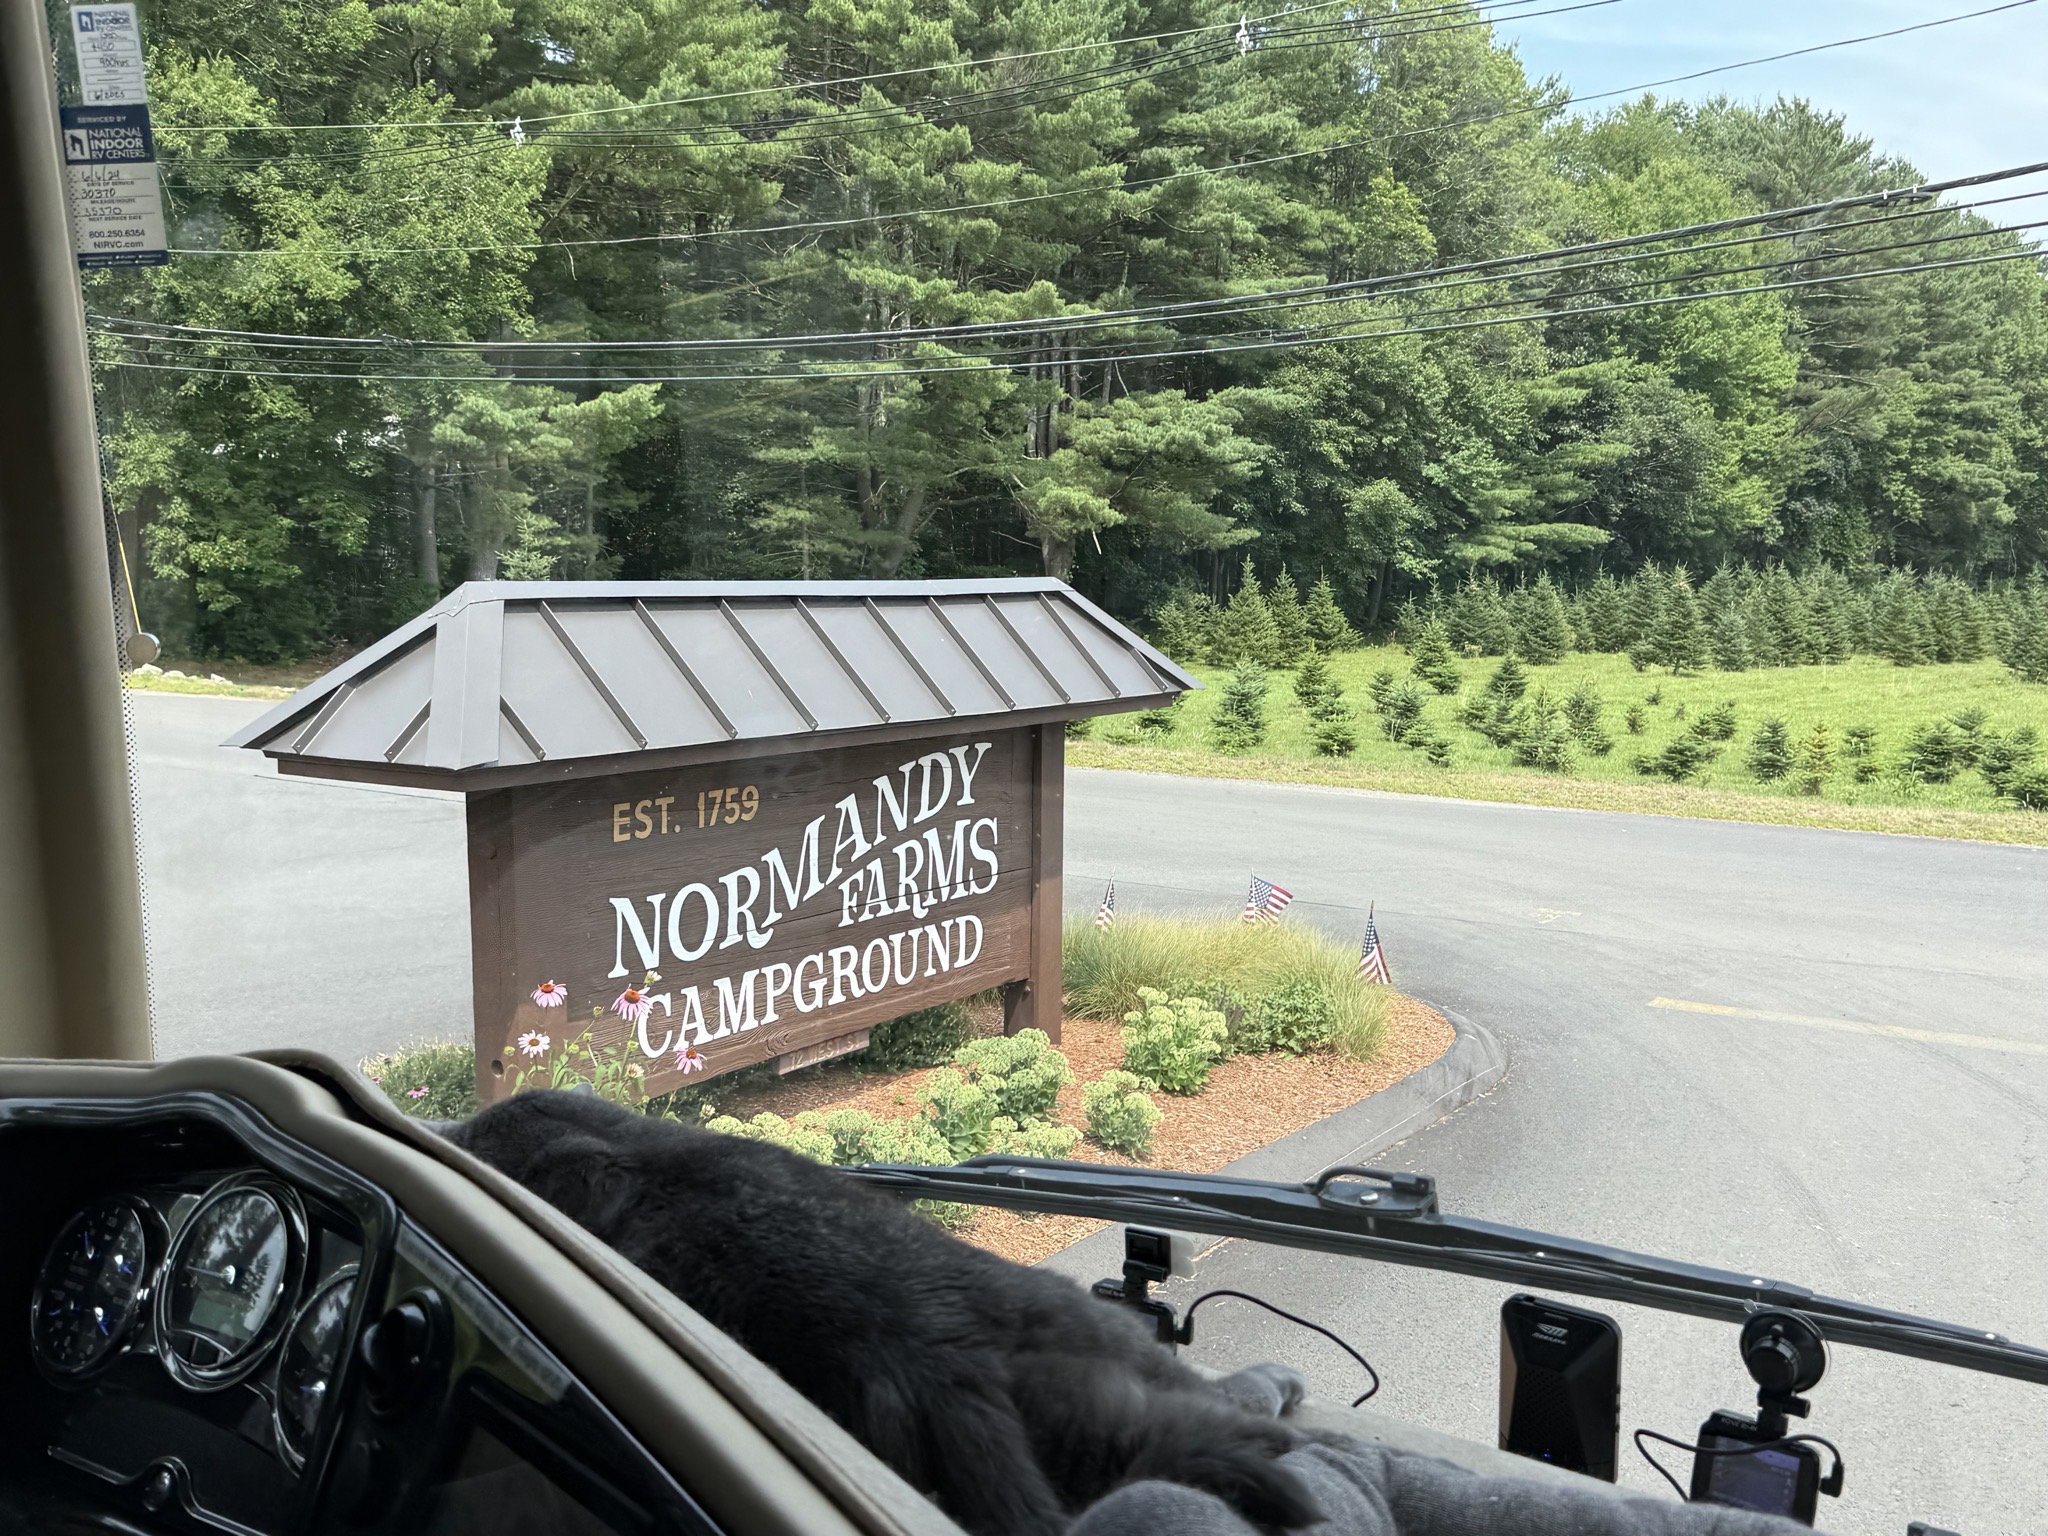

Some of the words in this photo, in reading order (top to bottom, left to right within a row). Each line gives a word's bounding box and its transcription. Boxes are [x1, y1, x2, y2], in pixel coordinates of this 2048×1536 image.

[89, 127, 143, 139] NATIONAL
[90, 138, 144, 150] INDOOR
[92, 150, 104, 159] RV
[106, 149, 145, 159] CENTERS
[81, 187, 116, 199] 30370
[89, 229, 145, 238] 800.250.6354
[93, 240, 144, 249] NIRVC.com
[613, 796, 681, 843] EST.
[697, 785, 760, 828] 1759
[608, 742, 992, 979] NORMANDY
[838, 817, 999, 928] FARMS
[637, 914, 984, 1059] CAMPGROUND
